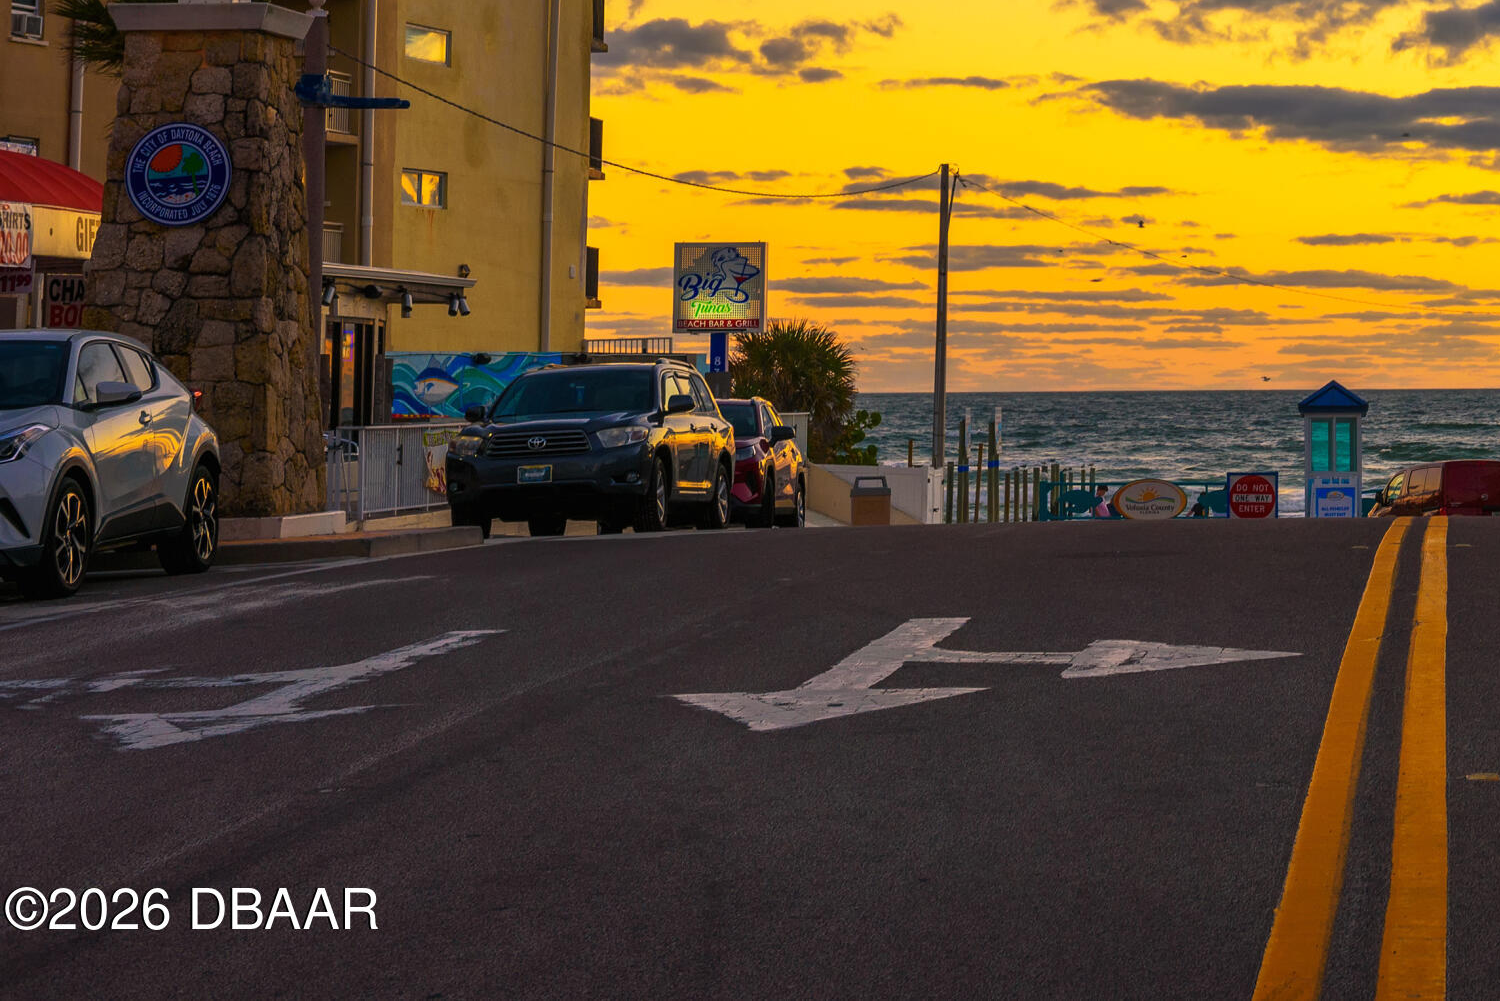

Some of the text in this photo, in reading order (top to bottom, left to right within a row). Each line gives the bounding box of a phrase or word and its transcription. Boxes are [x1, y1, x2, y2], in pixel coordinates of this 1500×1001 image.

[132, 128, 223, 173] THE CITY OF DAYTONA BEACH
[137, 184, 222, 220] INCORPORATED JULY 1876
[76, 216, 100, 252] GIF
[678, 272, 730, 302] Big
[691, 301, 731, 317] Tunas
[678, 320, 759, 328] BEACH BAR & GRILL
[1236, 484, 1269, 492] DO NOT
[1235, 494, 1270, 502] ONE WAY
[1151, 503, 1175, 512] County
[1239, 504, 1265, 513] ENTER
